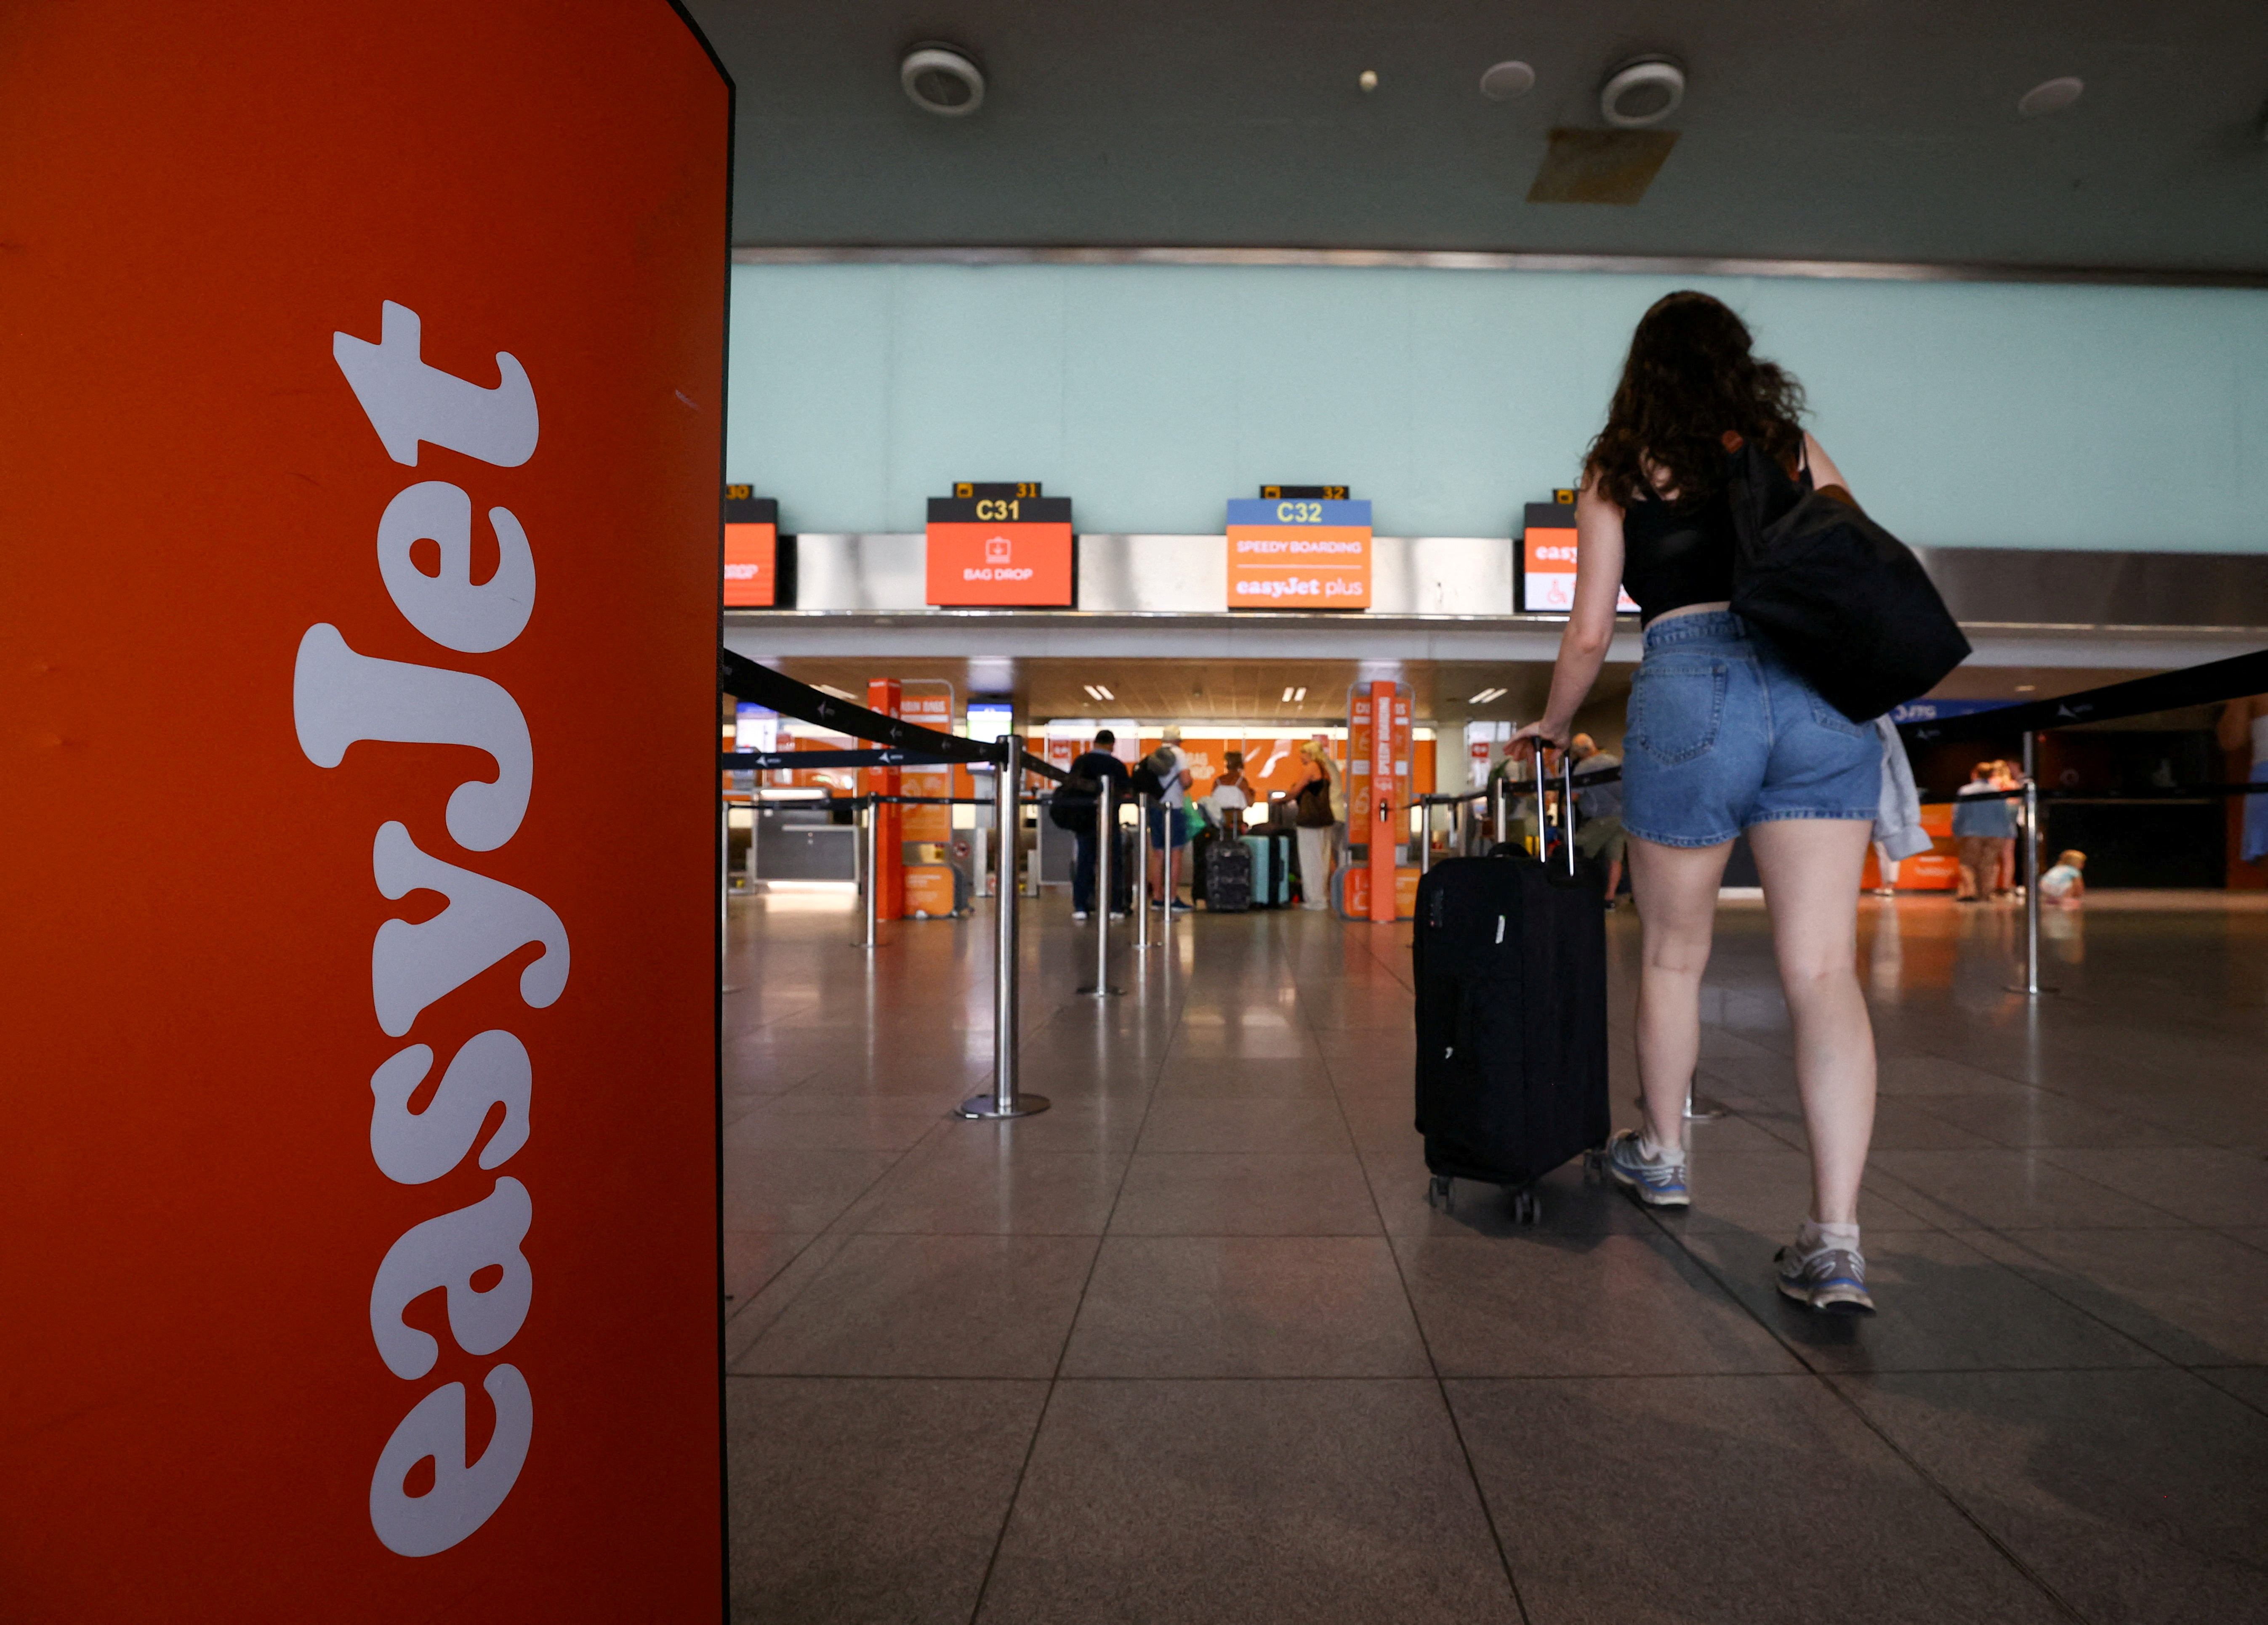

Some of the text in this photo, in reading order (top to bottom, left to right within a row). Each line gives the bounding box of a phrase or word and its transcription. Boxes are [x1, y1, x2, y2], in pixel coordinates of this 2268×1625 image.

[1016, 483, 1038, 498] 31
[1322, 487, 1345, 500] 32
[975, 499, 1020, 521] C31
[1276, 502, 1323, 523] C32
[1236, 540, 1362, 554] SPEEDY BOARDING
[963, 569, 1033, 581] BAG DROP
[1236, 577, 1363, 598] easyJet plus
[293, 298, 571, 1558] easyJet
